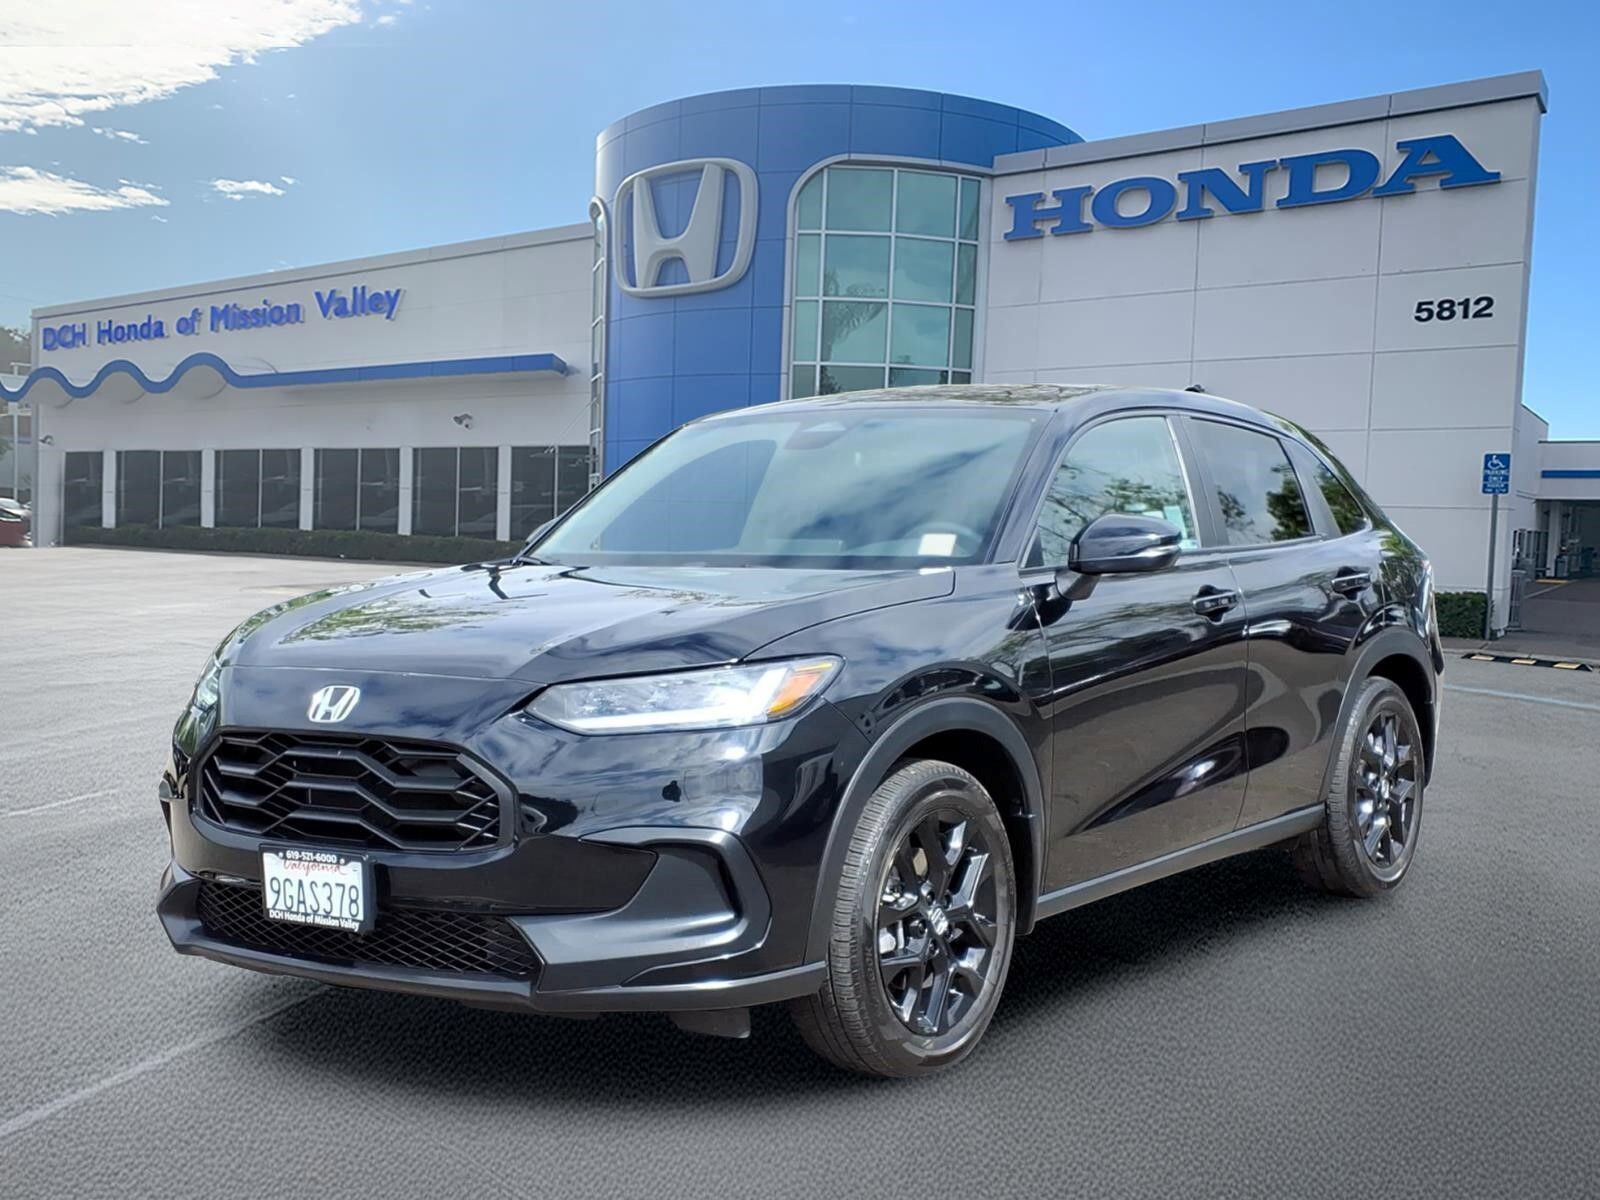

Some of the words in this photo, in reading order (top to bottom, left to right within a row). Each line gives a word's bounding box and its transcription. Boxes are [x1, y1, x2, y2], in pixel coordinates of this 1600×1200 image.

[1003, 134, 1501, 241] HONDA
[42, 323, 87, 351] DCH
[97, 314, 166, 345] Honda
[176, 307, 202, 335] of
[210, 298, 304, 333] Mission
[314, 285, 402, 321] Valley
[1413, 296, 1495, 323] 5812
[269, 876, 360, 918] 9GAS378
[284, 911, 306, 923] Honda
[306, 914, 315, 924] of
[314, 914, 340, 928] Mission
[340, 918, 360, 933] Valley
